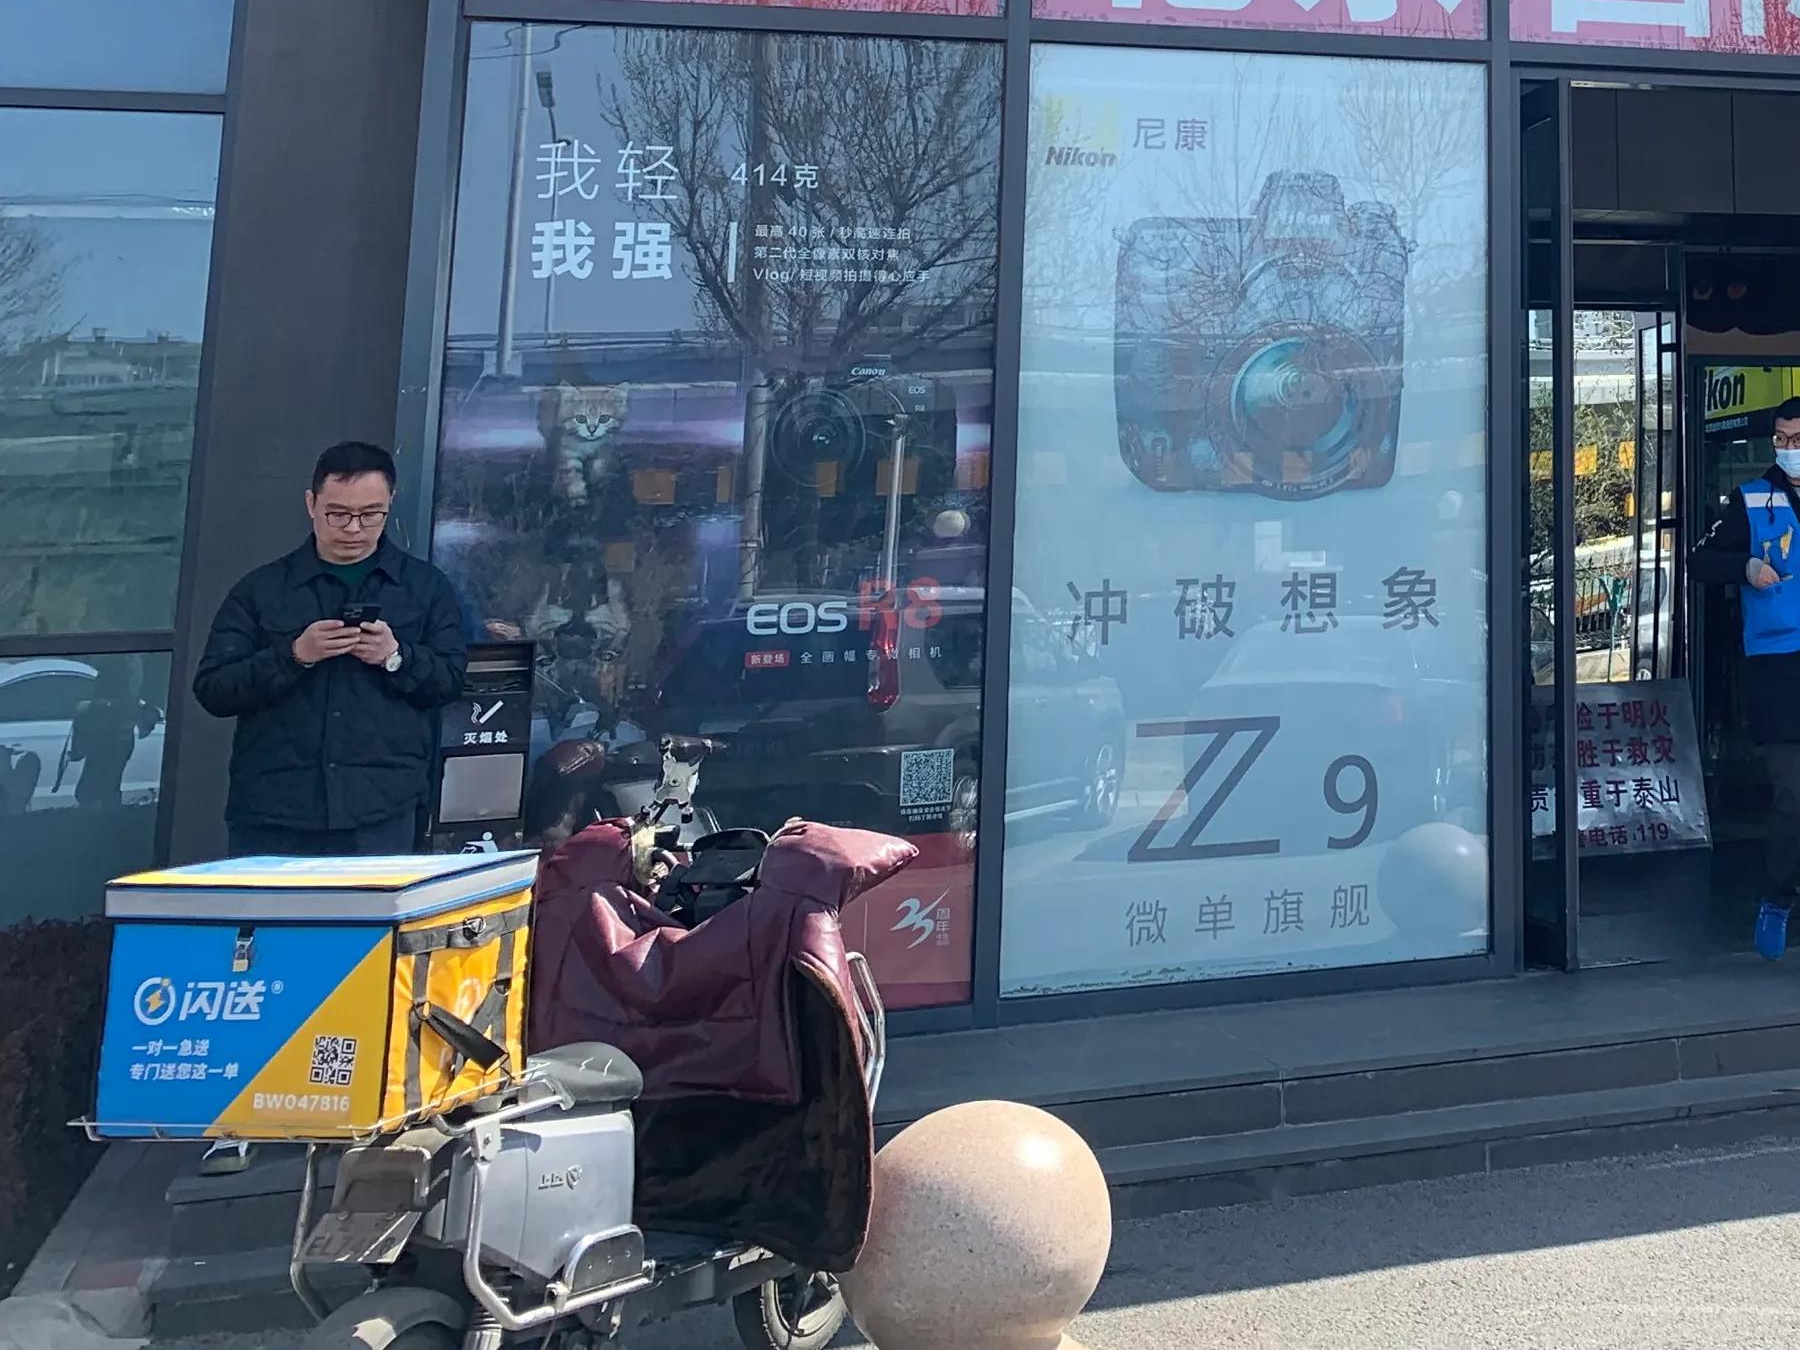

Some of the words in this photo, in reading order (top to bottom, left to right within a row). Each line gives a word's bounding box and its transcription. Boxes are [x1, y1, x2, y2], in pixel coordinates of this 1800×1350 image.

[1133, 117, 1209, 152] 尼康
[535, 139, 679, 202] 我轻
[1045, 146, 1117, 168] Nikon
[731, 163, 819, 189] 414克
[531, 218, 673, 281] 我强
[851, 367, 886, 376] Canon
[908, 386, 926, 394] EOS
[747, 601, 848, 636] EOS
[1066, 566, 1440, 646] 冲破想象
[463, 730, 508, 745] 灭烟处
[1323, 754, 1379, 850] 9
[1580, 775, 1681, 810] 重于泰山
[1125, 883, 1371, 947] 微单旗舰
[179, 980, 267, 1021] 闪送
[131, 1039, 210, 1057] 一对一急送
[129, 1062, 240, 1081] 专门送您这一单
[252, 1093, 350, 1113] BW047816
